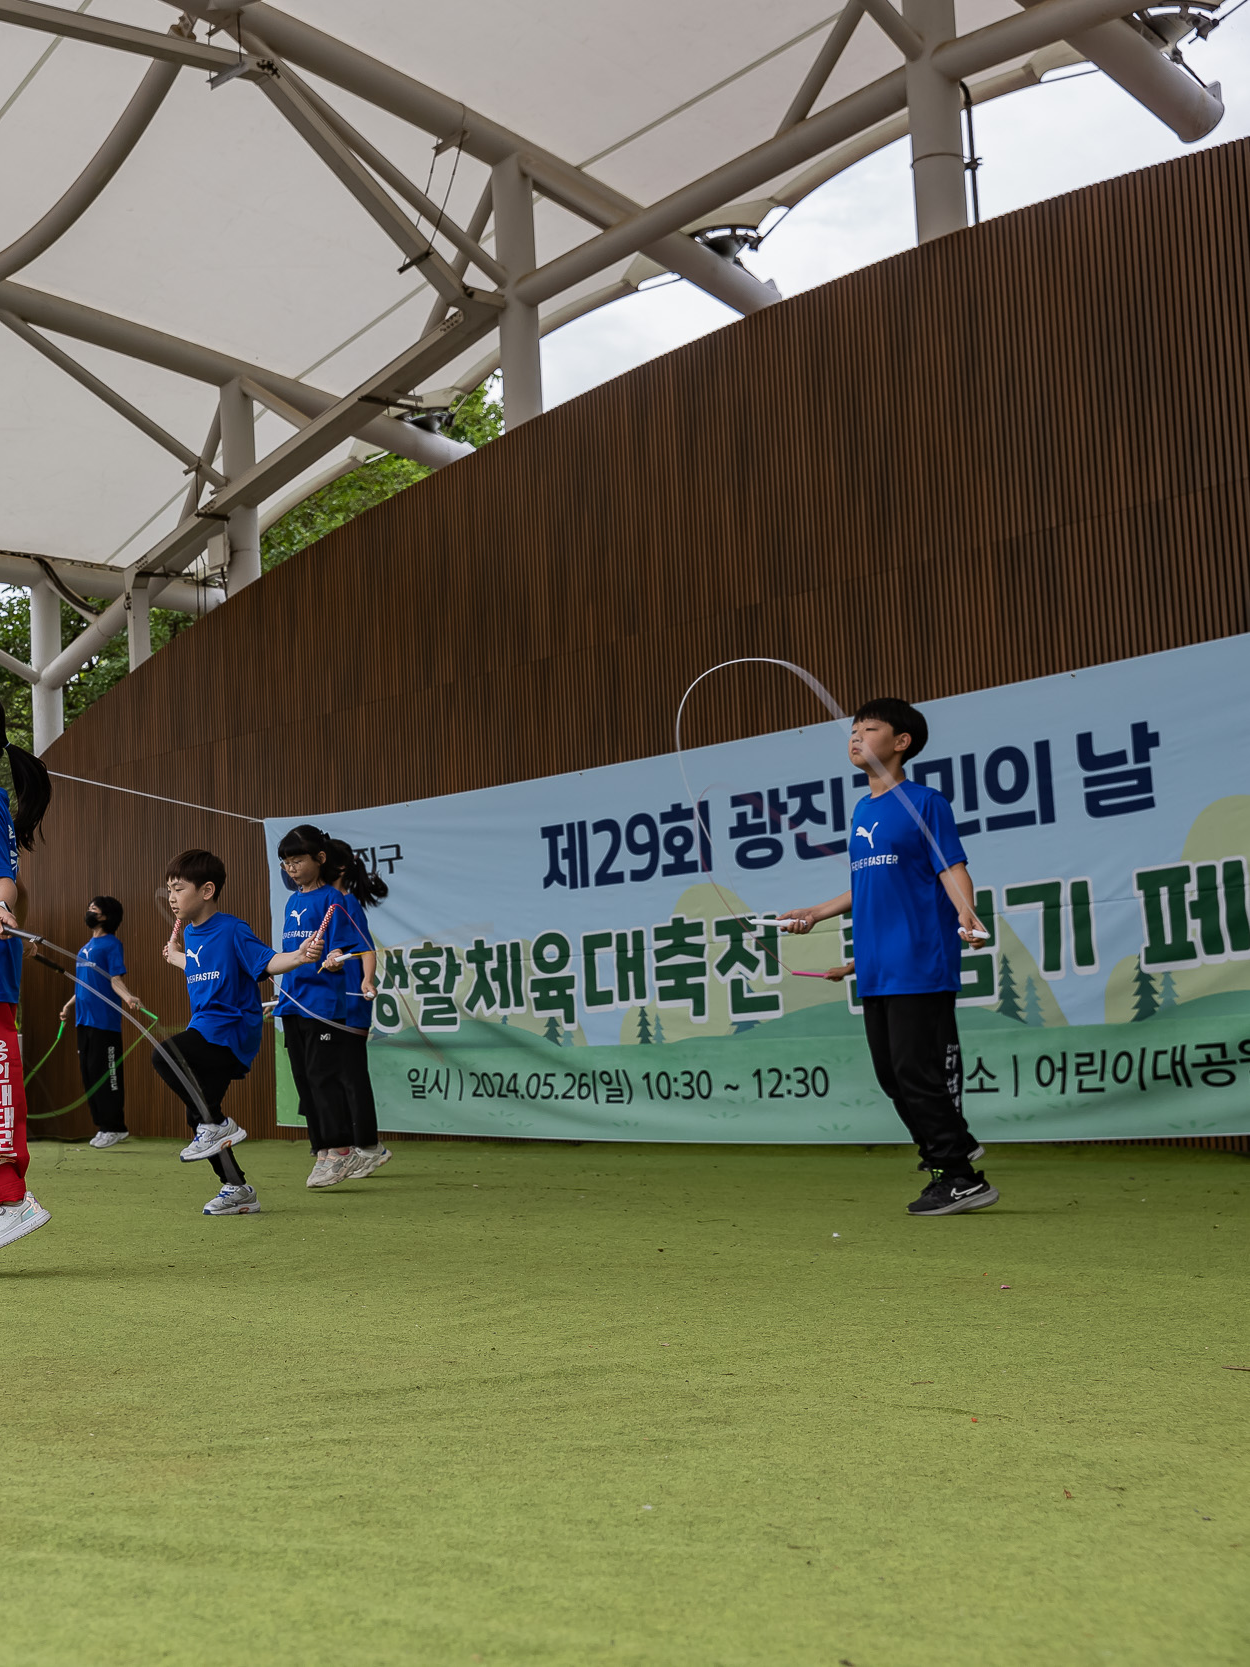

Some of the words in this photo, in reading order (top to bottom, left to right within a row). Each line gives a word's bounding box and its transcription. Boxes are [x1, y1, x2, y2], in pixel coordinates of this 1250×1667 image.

[540, 799, 713, 890] 제29회
[728, 738, 1056, 871] 광진민의
[1075, 720, 1161, 819] 날
[374, 912, 783, 1030] 생활체육대축전
[406, 1067, 450, 1101] 일시
[468, 1068, 634, 1105] 2024.05.26(일)
[641, 1069, 713, 1101] 10:30
[751, 1065, 830, 1099] 12:30
